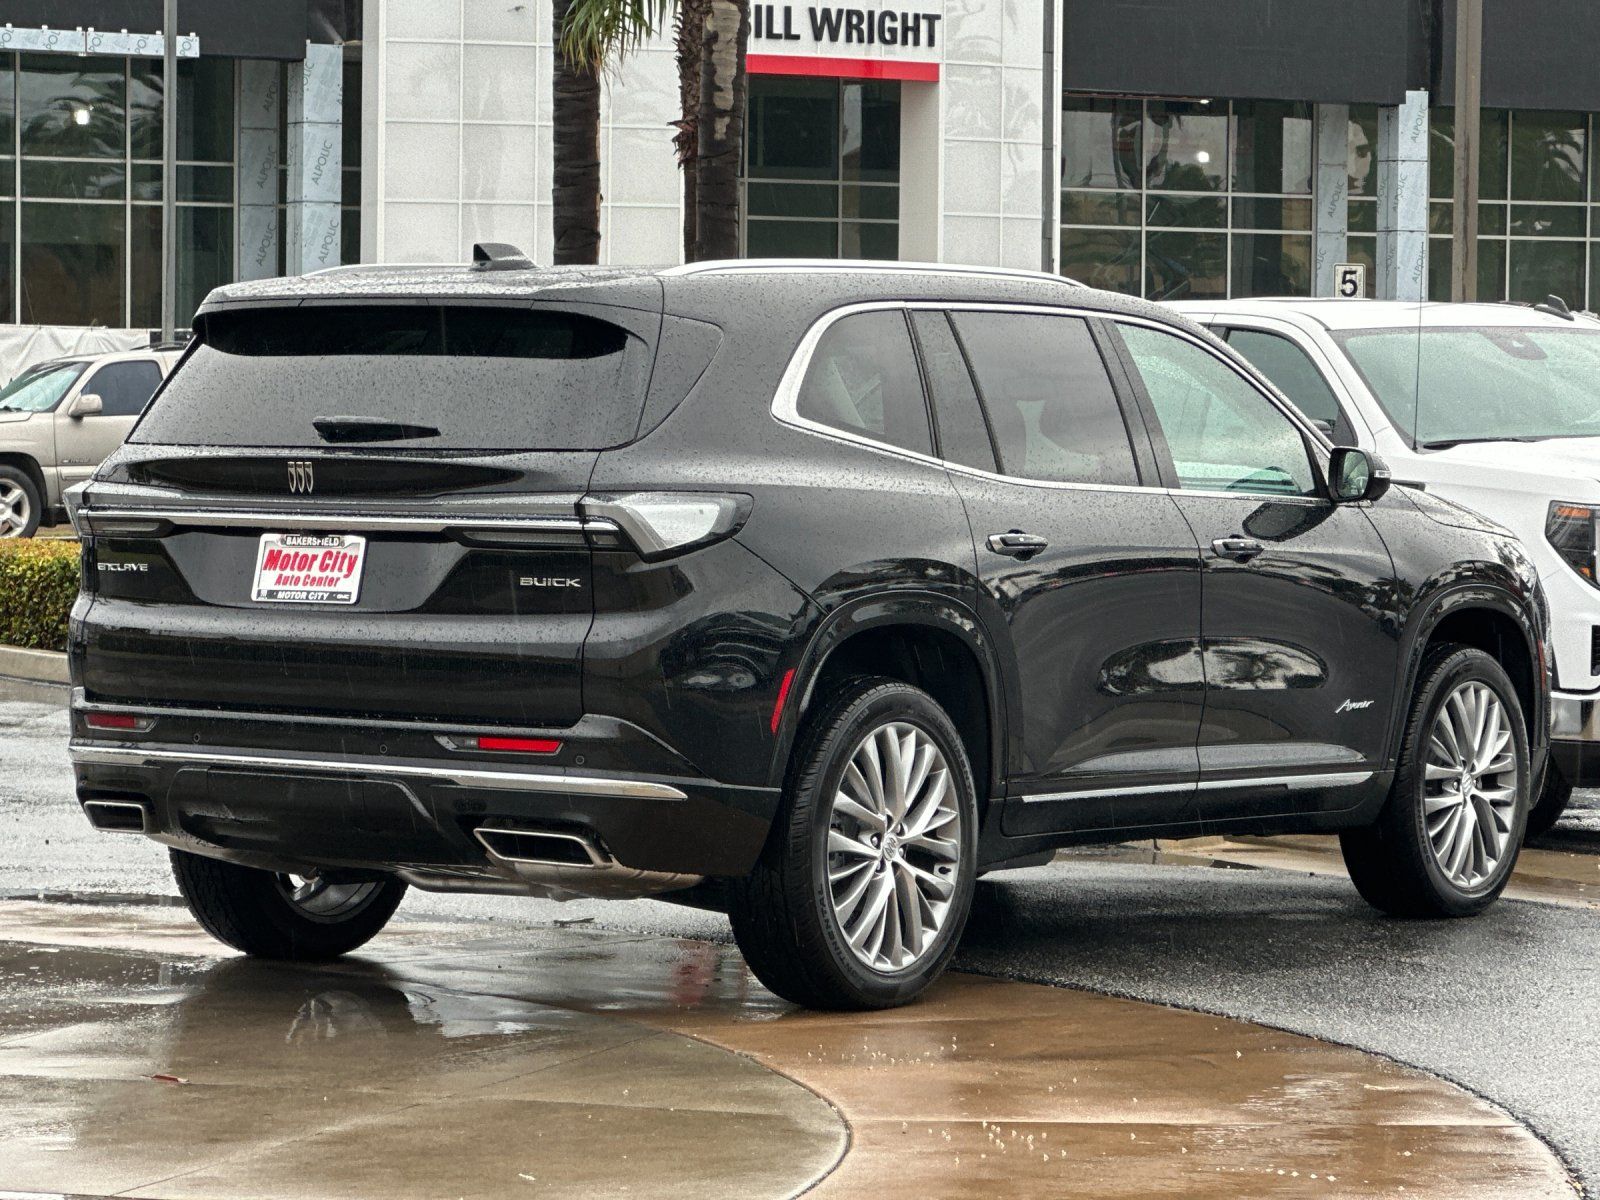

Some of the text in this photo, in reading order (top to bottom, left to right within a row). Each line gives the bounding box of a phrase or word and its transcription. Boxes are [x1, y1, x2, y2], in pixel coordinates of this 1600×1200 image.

[808, 7, 942, 47] WRIGHT
[1411, 103, 1427, 143] ALPOLIC
[257, 145, 277, 189] ALPOLIC
[311, 139, 333, 186] ALPOLIC
[1328, 177, 1345, 218] ALPOLIC
[255, 222, 276, 267] ALPOLIC
[317, 219, 340, 265] ALPOLIC
[1340, 270, 1358, 297] 5
[286, 536, 340, 547] BAKERSFIELD
[97, 562, 148, 572] ENCLAVE
[262, 549, 358, 579] Motor City
[274, 573, 341, 588] Auto Center
[277, 591, 307, 600] MOTOR
[309, 592, 329, 601] CITY
[519, 577, 581, 587] BUICK
